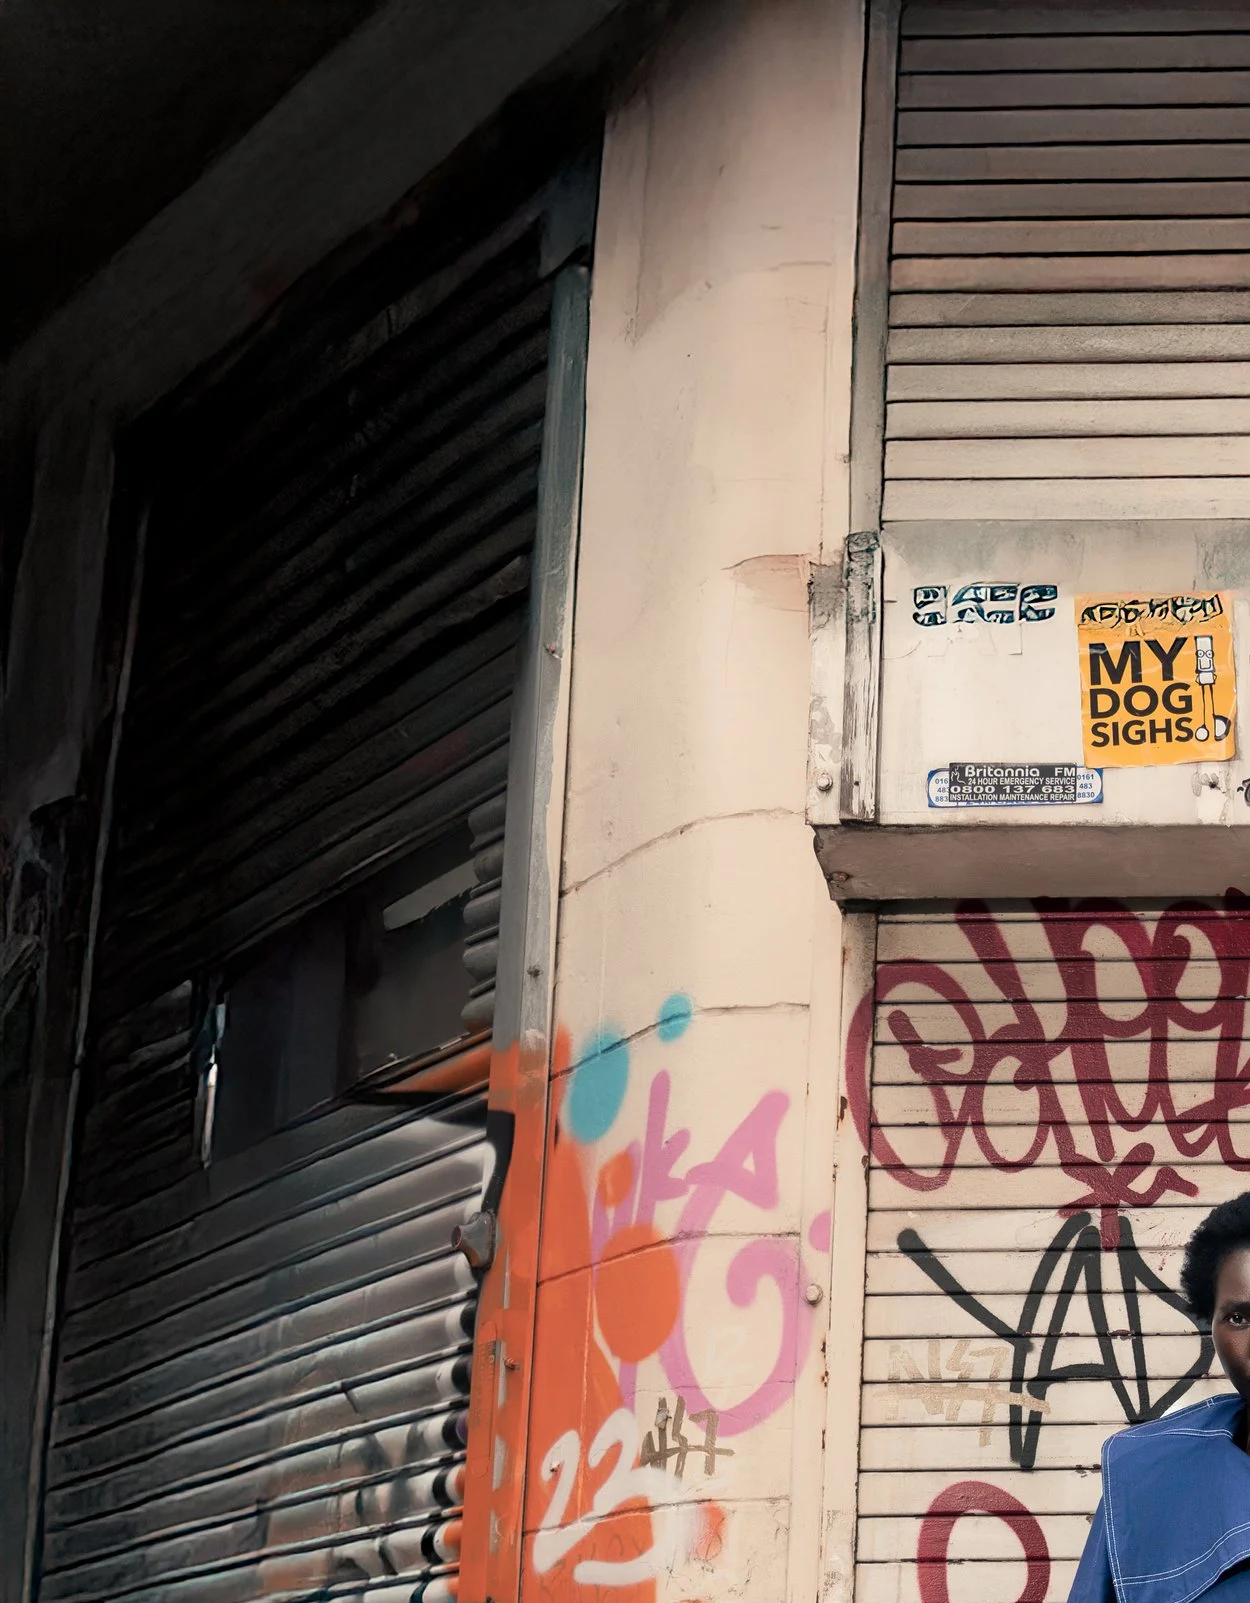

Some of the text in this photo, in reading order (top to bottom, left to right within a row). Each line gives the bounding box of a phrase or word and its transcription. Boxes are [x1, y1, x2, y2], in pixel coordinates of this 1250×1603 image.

[1089, 635, 1189, 686] MY
[1089, 682, 1193, 720] DOG
[1090, 717, 1194, 748] SIGHS
[964, 765, 1075, 778] Britannia FM
[968, 777, 1075, 785] 24 HOUR EMERGENCY SERVICE
[950, 785, 1075, 794] 0800 137 683
[950, 793, 1075, 801] INSTALLATION MAINTENANCE REPAIR
